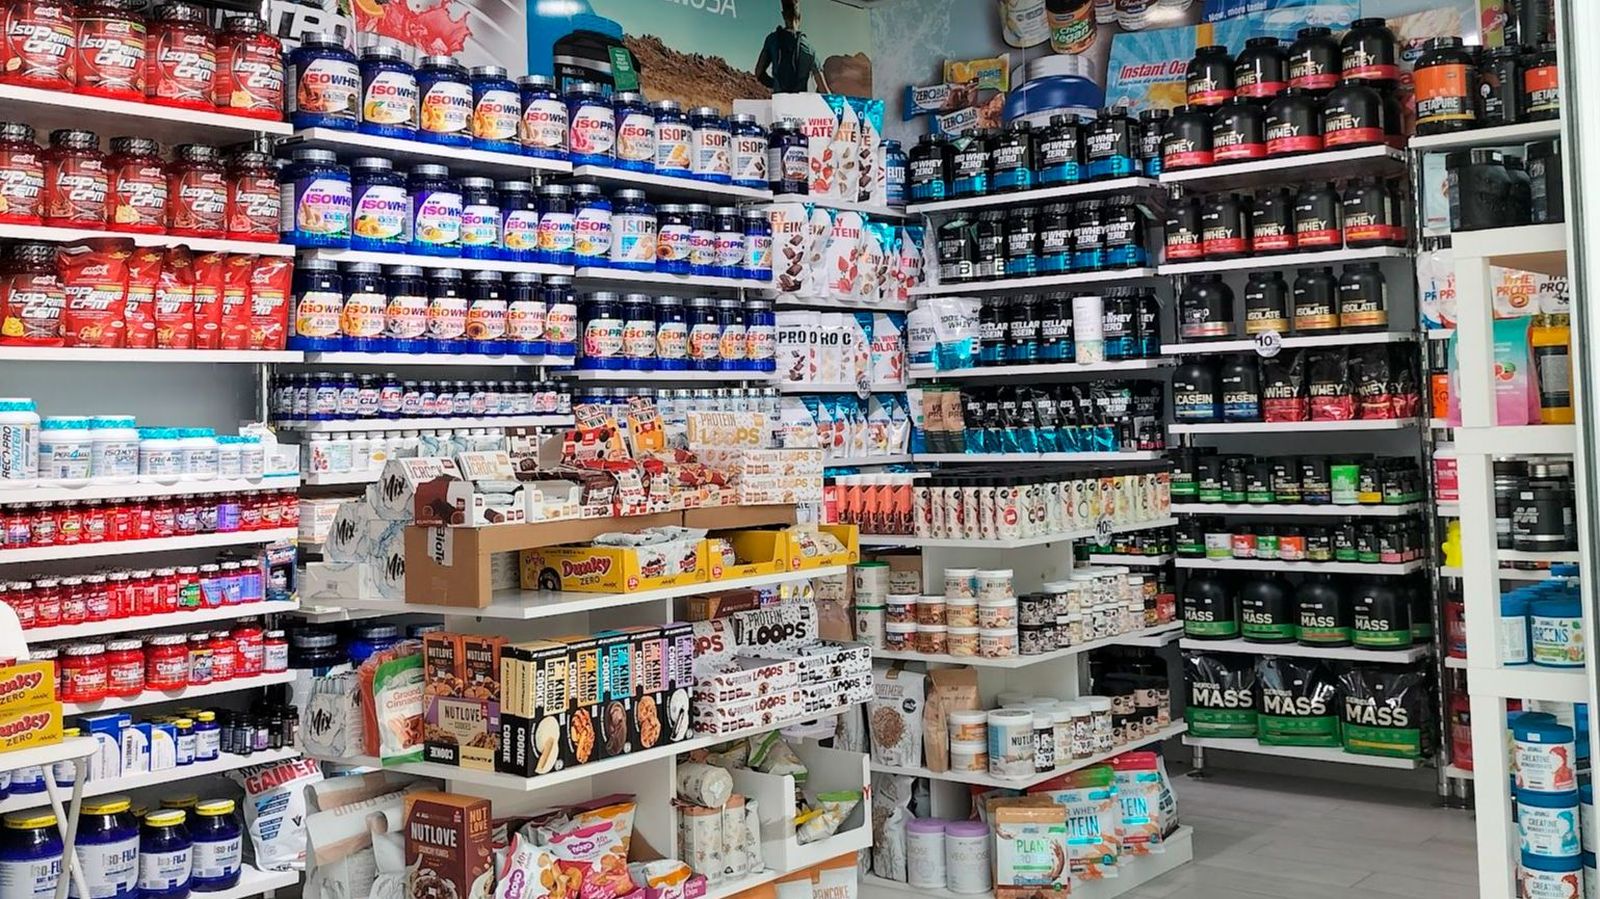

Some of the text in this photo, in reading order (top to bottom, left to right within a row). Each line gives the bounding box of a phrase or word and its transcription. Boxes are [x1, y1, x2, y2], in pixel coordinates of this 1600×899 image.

[1119, 59, 1189, 80] Instant Oa
[1290, 62, 1324, 78] WHEY
[426, 94, 473, 110] ISOWHE
[808, 116, 834, 127] WHEY
[841, 121, 857, 131] HEY
[1325, 117, 1361, 132] WHEY
[658, 128, 692, 144] ISOPR
[804, 126, 834, 138] LATE
[835, 131, 857, 143] ATE
[1266, 125, 1300, 139] WHEY
[1052, 138, 1078, 150] WHEY
[1096, 133, 1122, 145] WHEY
[1213, 133, 1246, 146] WHEY
[1003, 145, 1026, 157] WHEY
[1045, 147, 1067, 158] ZERO
[1090, 142, 1112, 153] ZERO
[918, 158, 943, 169] WHEY
[965, 151, 990, 163] WHEY
[996, 153, 1017, 163] ZERO
[914, 166, 934, 177] ZERO
[960, 160, 983, 170] ZERO
[575, 221, 611, 233] ISOPR
[622, 219, 657, 234] ISOPR
[1109, 221, 1135, 233] WHEY
[1297, 220, 1328, 233] WHEY
[1346, 215, 1377, 227] WHEY
[1048, 230, 1072, 241] WHEY
[1081, 226, 1106, 237] WHEY
[1203, 228, 1233, 241] WHEY
[1255, 225, 1287, 239] WHEY
[1168, 233, 1199, 245] WHEY
[1503, 274, 1535, 285] WHE
[299, 304, 342, 315] ISOWH
[345, 305, 386, 316] ISOWH
[1295, 305, 1330, 316] ISOLATE
[1341, 301, 1378, 313] ISOLATE
[1105, 312, 1132, 326] WHEY
[1247, 309, 1281, 321] ISOLATE
[587, 328, 623, 339] ISOPR
[1265, 386, 1300, 399] WHEY
[1310, 384, 1344, 397] WHEY
[1174, 393, 1213, 405] CASEIN
[1224, 393, 1258, 404] CASEIN
[701, 413, 736, 427] PROTEIN
[11, 426, 21, 472] PROTEIN
[383, 475, 407, 502] Mix
[335, 518, 357, 545] Mix
[561, 556, 612, 578] Dunky
[579, 575, 601, 586] ZERO
[747, 608, 784, 629] PROTEIN
[1185, 611, 1214, 623] MASS
[1242, 613, 1272, 625] MASS
[1300, 615, 1335, 628] MASS
[1355, 618, 1389, 631] MASS
[748, 621, 807, 646] LOOPS
[428, 646, 453, 660] NUTLOVE
[466, 649, 492, 662] NUTLOVE
[644, 643, 652, 691] DELICIOUS
[668, 645, 676, 681] COOKIE
[676, 637, 684, 686] DELICIOUS
[602, 655, 610, 692] COOKIE
[611, 647, 620, 697] DELICIOUS
[635, 650, 643, 687] COOKIE
[752, 664, 784, 682] LOOPS
[568, 662, 577, 699] COOKIE
[579, 653, 588, 704] DELICIOUS
[536, 669, 545, 709] COOKIE
[545, 660, 554, 713] DELICIOUS
[1, 690, 25, 705] ZERO
[392, 689, 416, 700] Ground
[1192, 687, 1253, 709] MASS
[755, 693, 787, 711] LOOPS
[1263, 695, 1327, 716] MASS
[444, 704, 480, 722] NUTLOVE
[1346, 702, 1408, 728] MASS
[310, 709, 333, 737] Mix
[6, 732, 33, 747] ZERO
[502, 723, 511, 764] COOKIE
[429, 746, 453, 760] COOKIE
[516, 726, 525, 768] COOKIE
[246, 757, 320, 796] GAINER
[469, 807, 488, 823] NUT
[1073, 806, 1098, 816] WHEY
[469, 819, 488, 833] LOVE
[1528, 818, 1558, 828] CREATINE
[410, 822, 457, 848] NUTLOVE
[1016, 839, 1045, 853] PLAN
[1532, 881, 1563, 892] CREATINE
